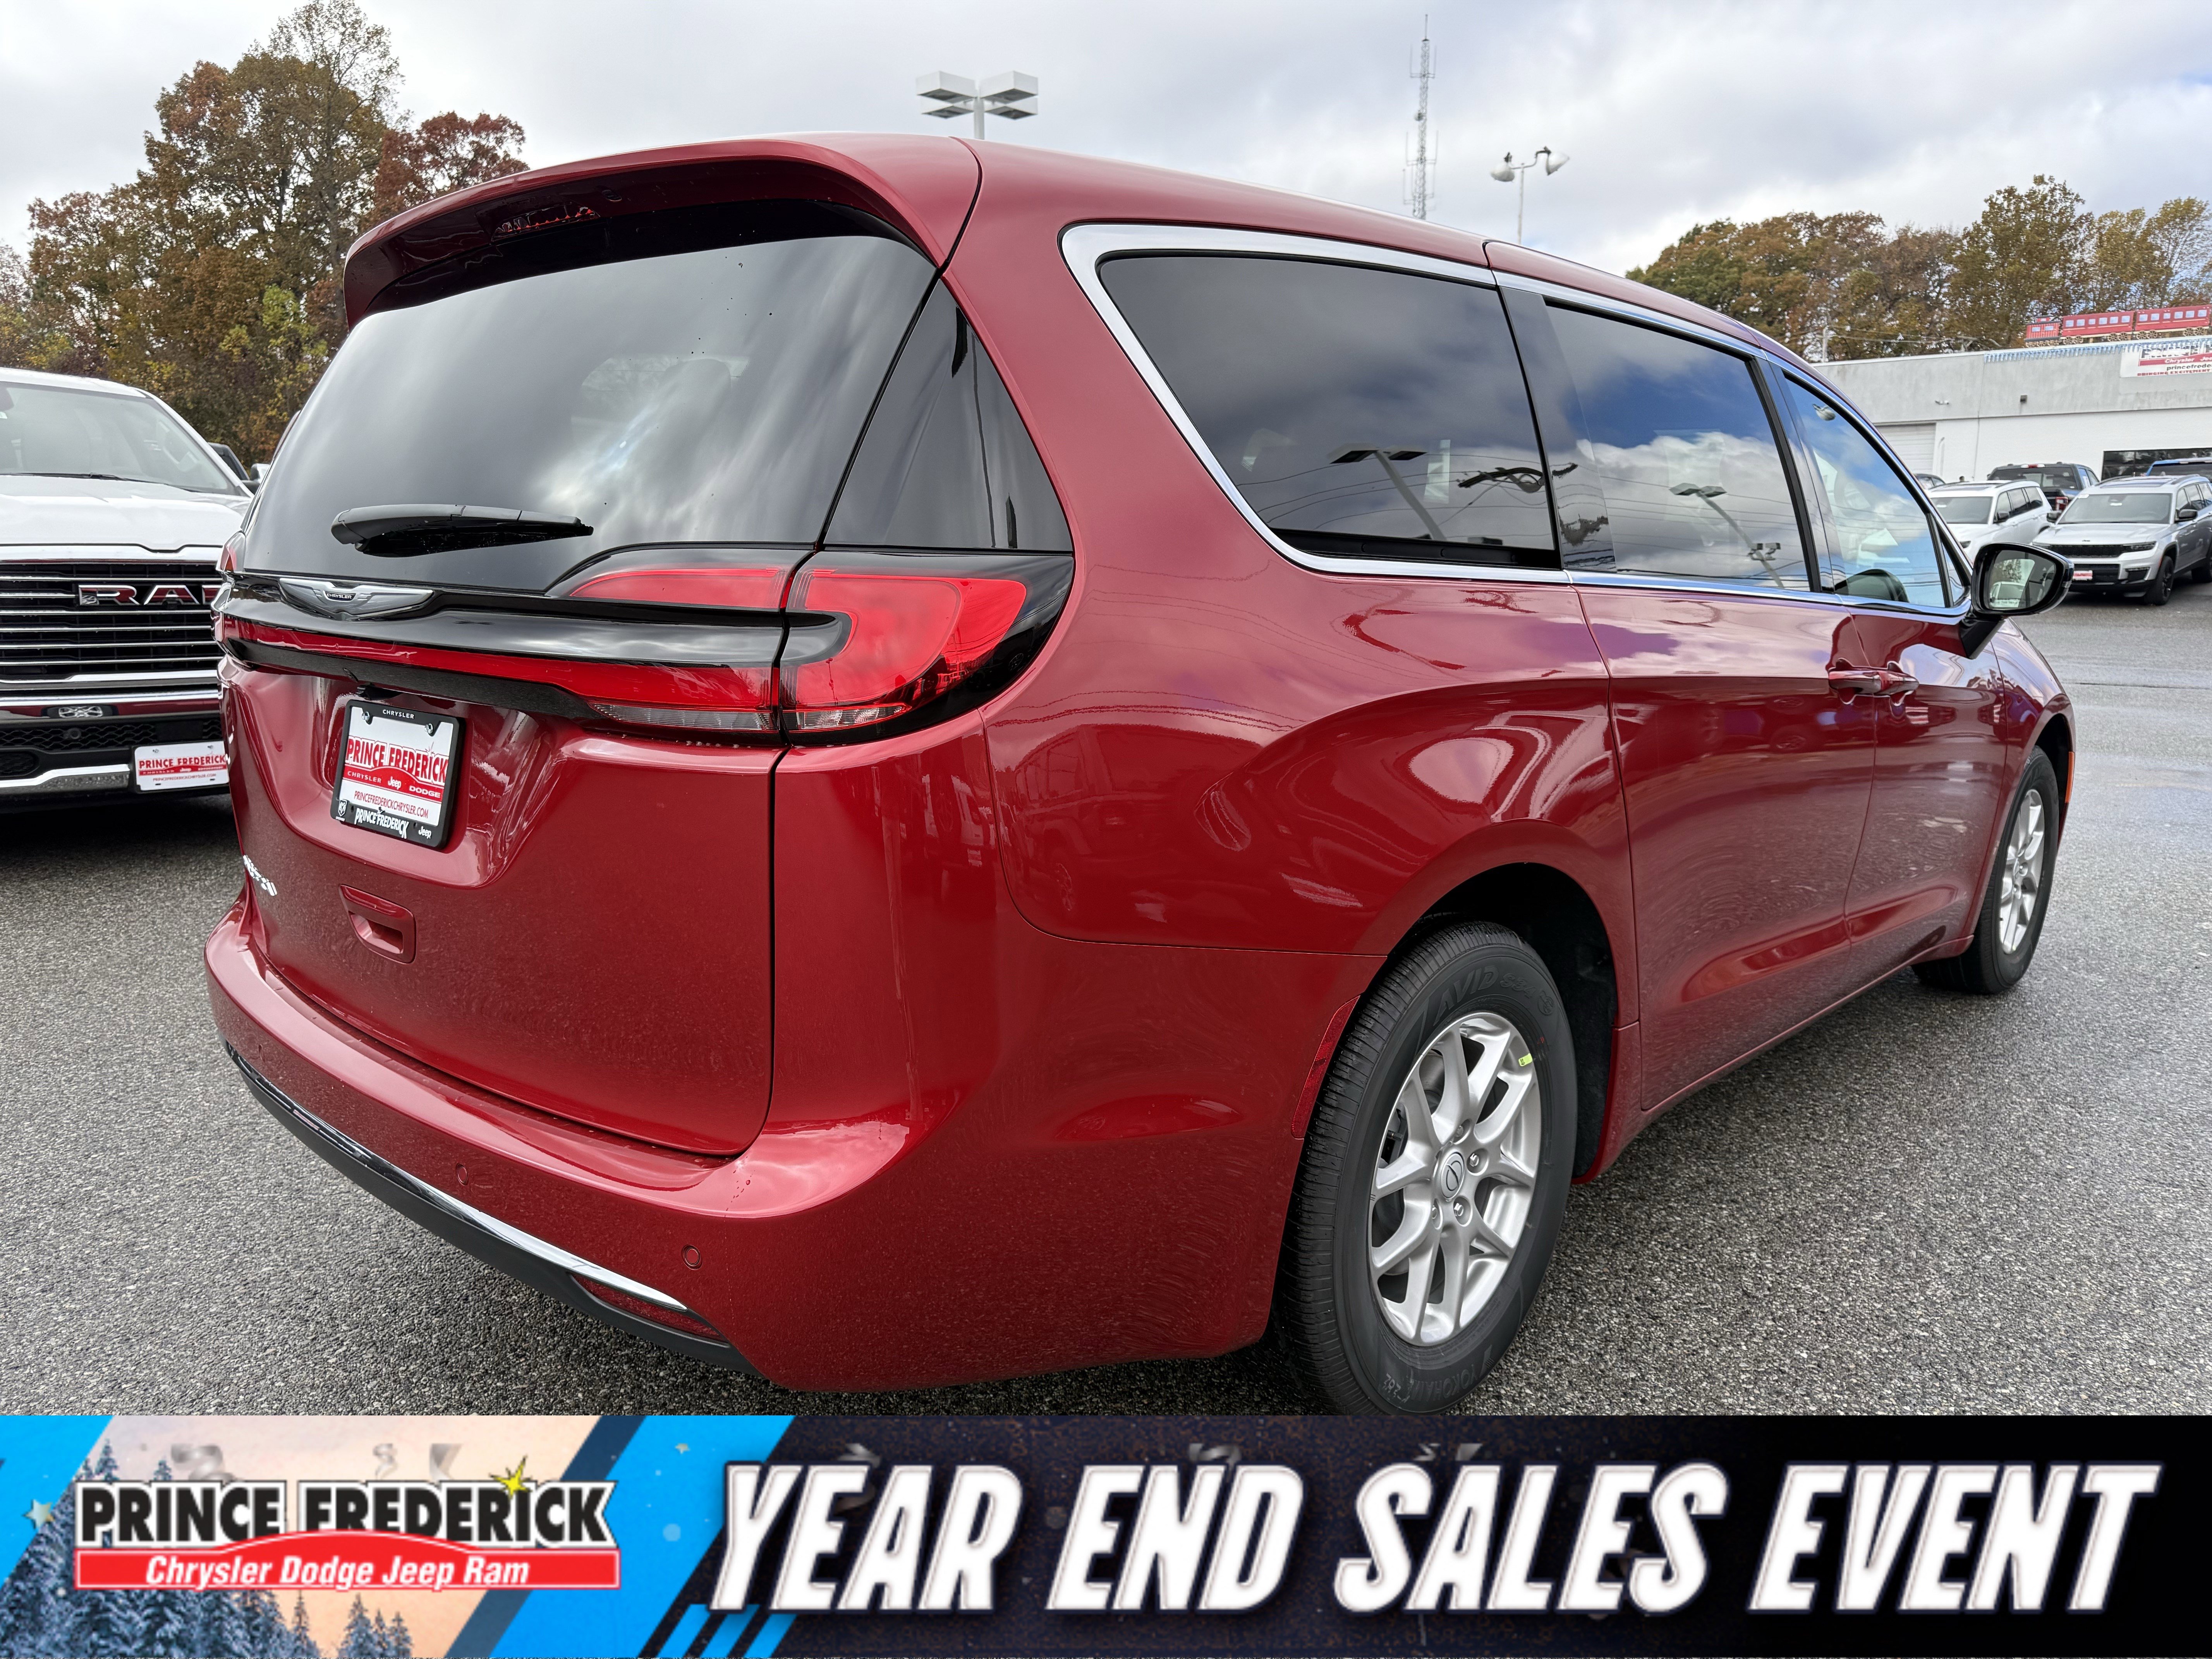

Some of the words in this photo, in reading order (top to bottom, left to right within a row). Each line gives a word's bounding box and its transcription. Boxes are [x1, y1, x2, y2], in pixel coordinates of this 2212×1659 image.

[383, 709, 414, 719] CHRYSLER
[139, 758, 173, 769] PRINCE
[177, 755, 226, 765] FREDERICK
[346, 738, 385, 767] PRINCE
[388, 746, 448, 784] FREDERICK
[347, 771, 381, 783] CHRYSLER
[388, 776, 402, 790] Jeep
[409, 785, 441, 798] DODGE
[354, 790, 429, 819] PRINCEFREDERICKCHRYSLER.COM
[354, 808, 376, 824] PRINCE
[376, 814, 409, 839] FREDERICK
[1433, 965, 1499, 1026] AVID
[1407, 1364, 1477, 1402] YOKOHAM
